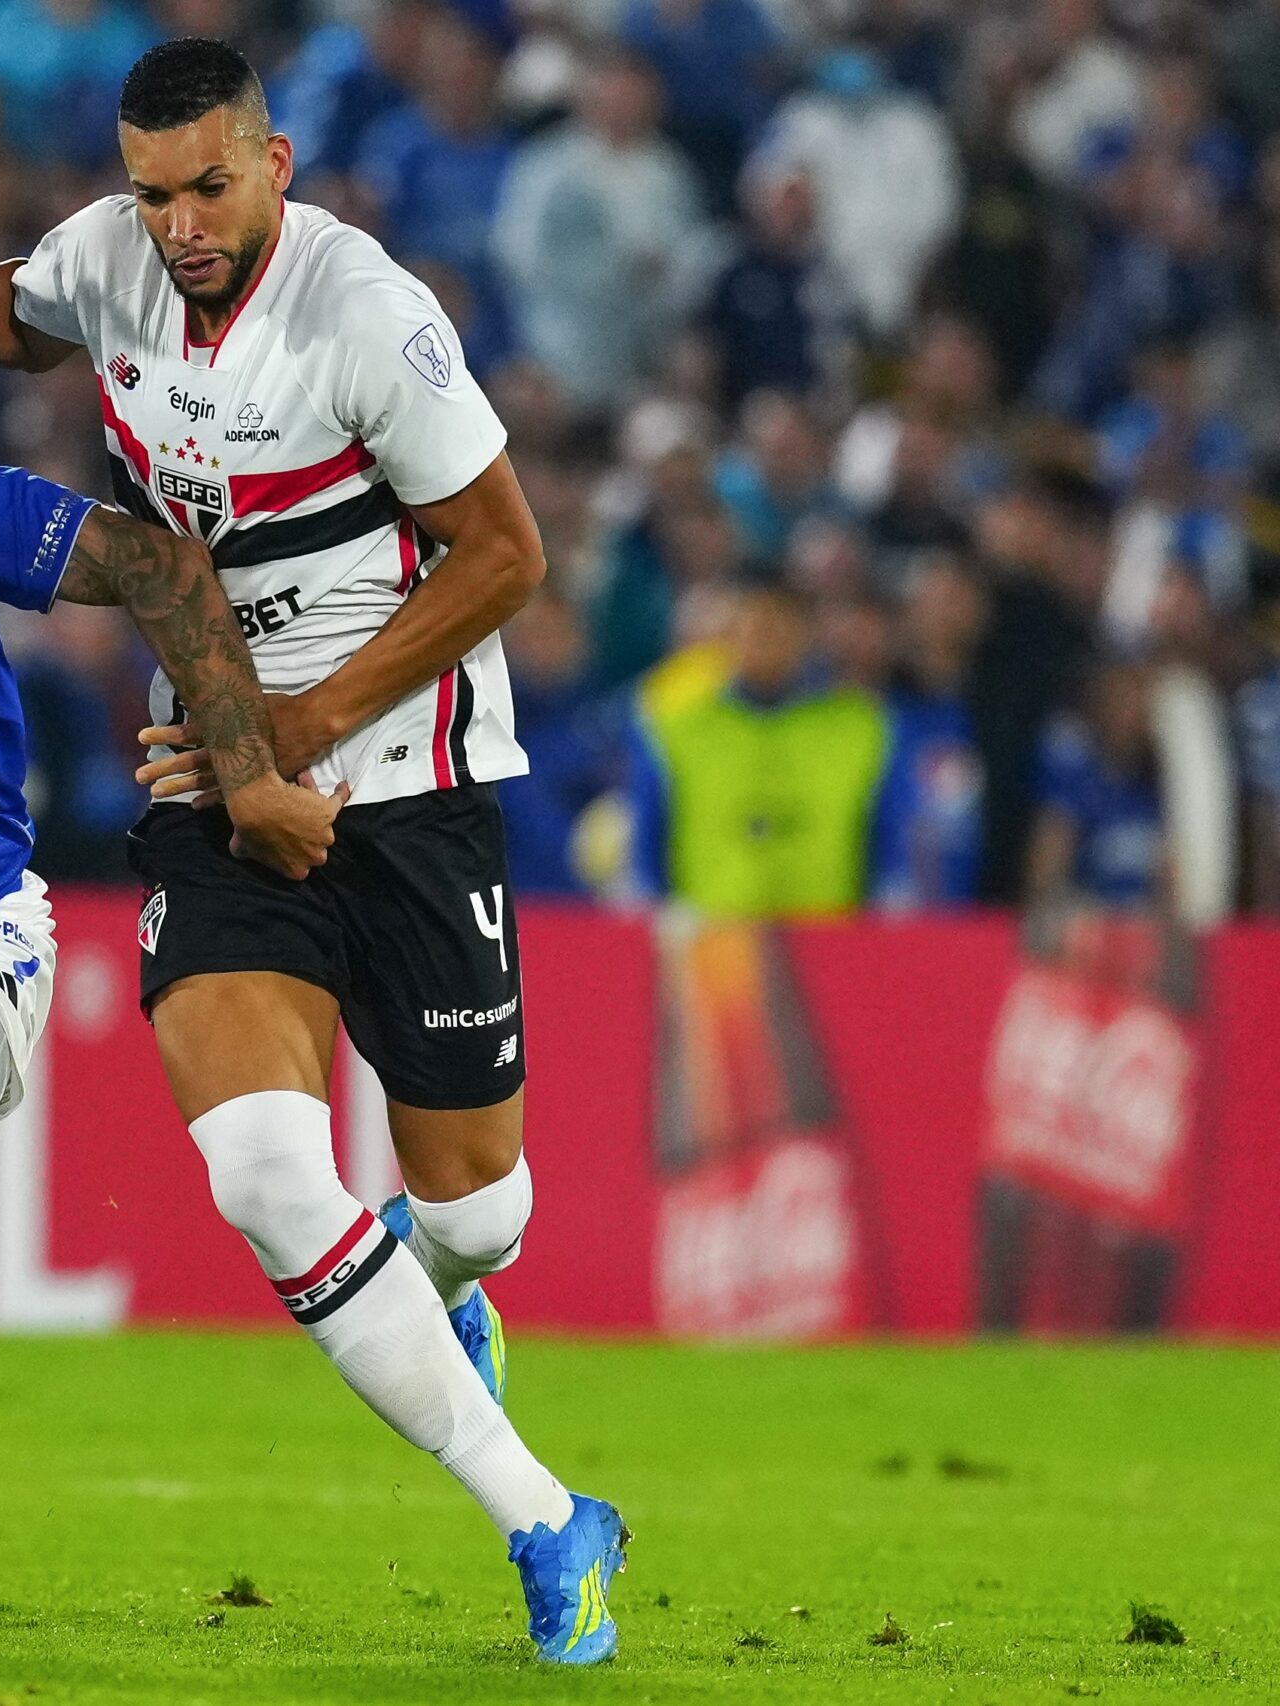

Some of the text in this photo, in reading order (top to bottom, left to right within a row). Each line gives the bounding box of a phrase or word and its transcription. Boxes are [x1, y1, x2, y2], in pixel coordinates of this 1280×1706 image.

[224, 429, 280, 442] ADEMICON
[162, 475, 220, 507] SPFC
[140, 897, 161, 931] SPFC
[469, 884, 508, 973] 4
[424, 995, 518, 1028] UniCesuma
[280, 1260, 357, 1311] PFC
